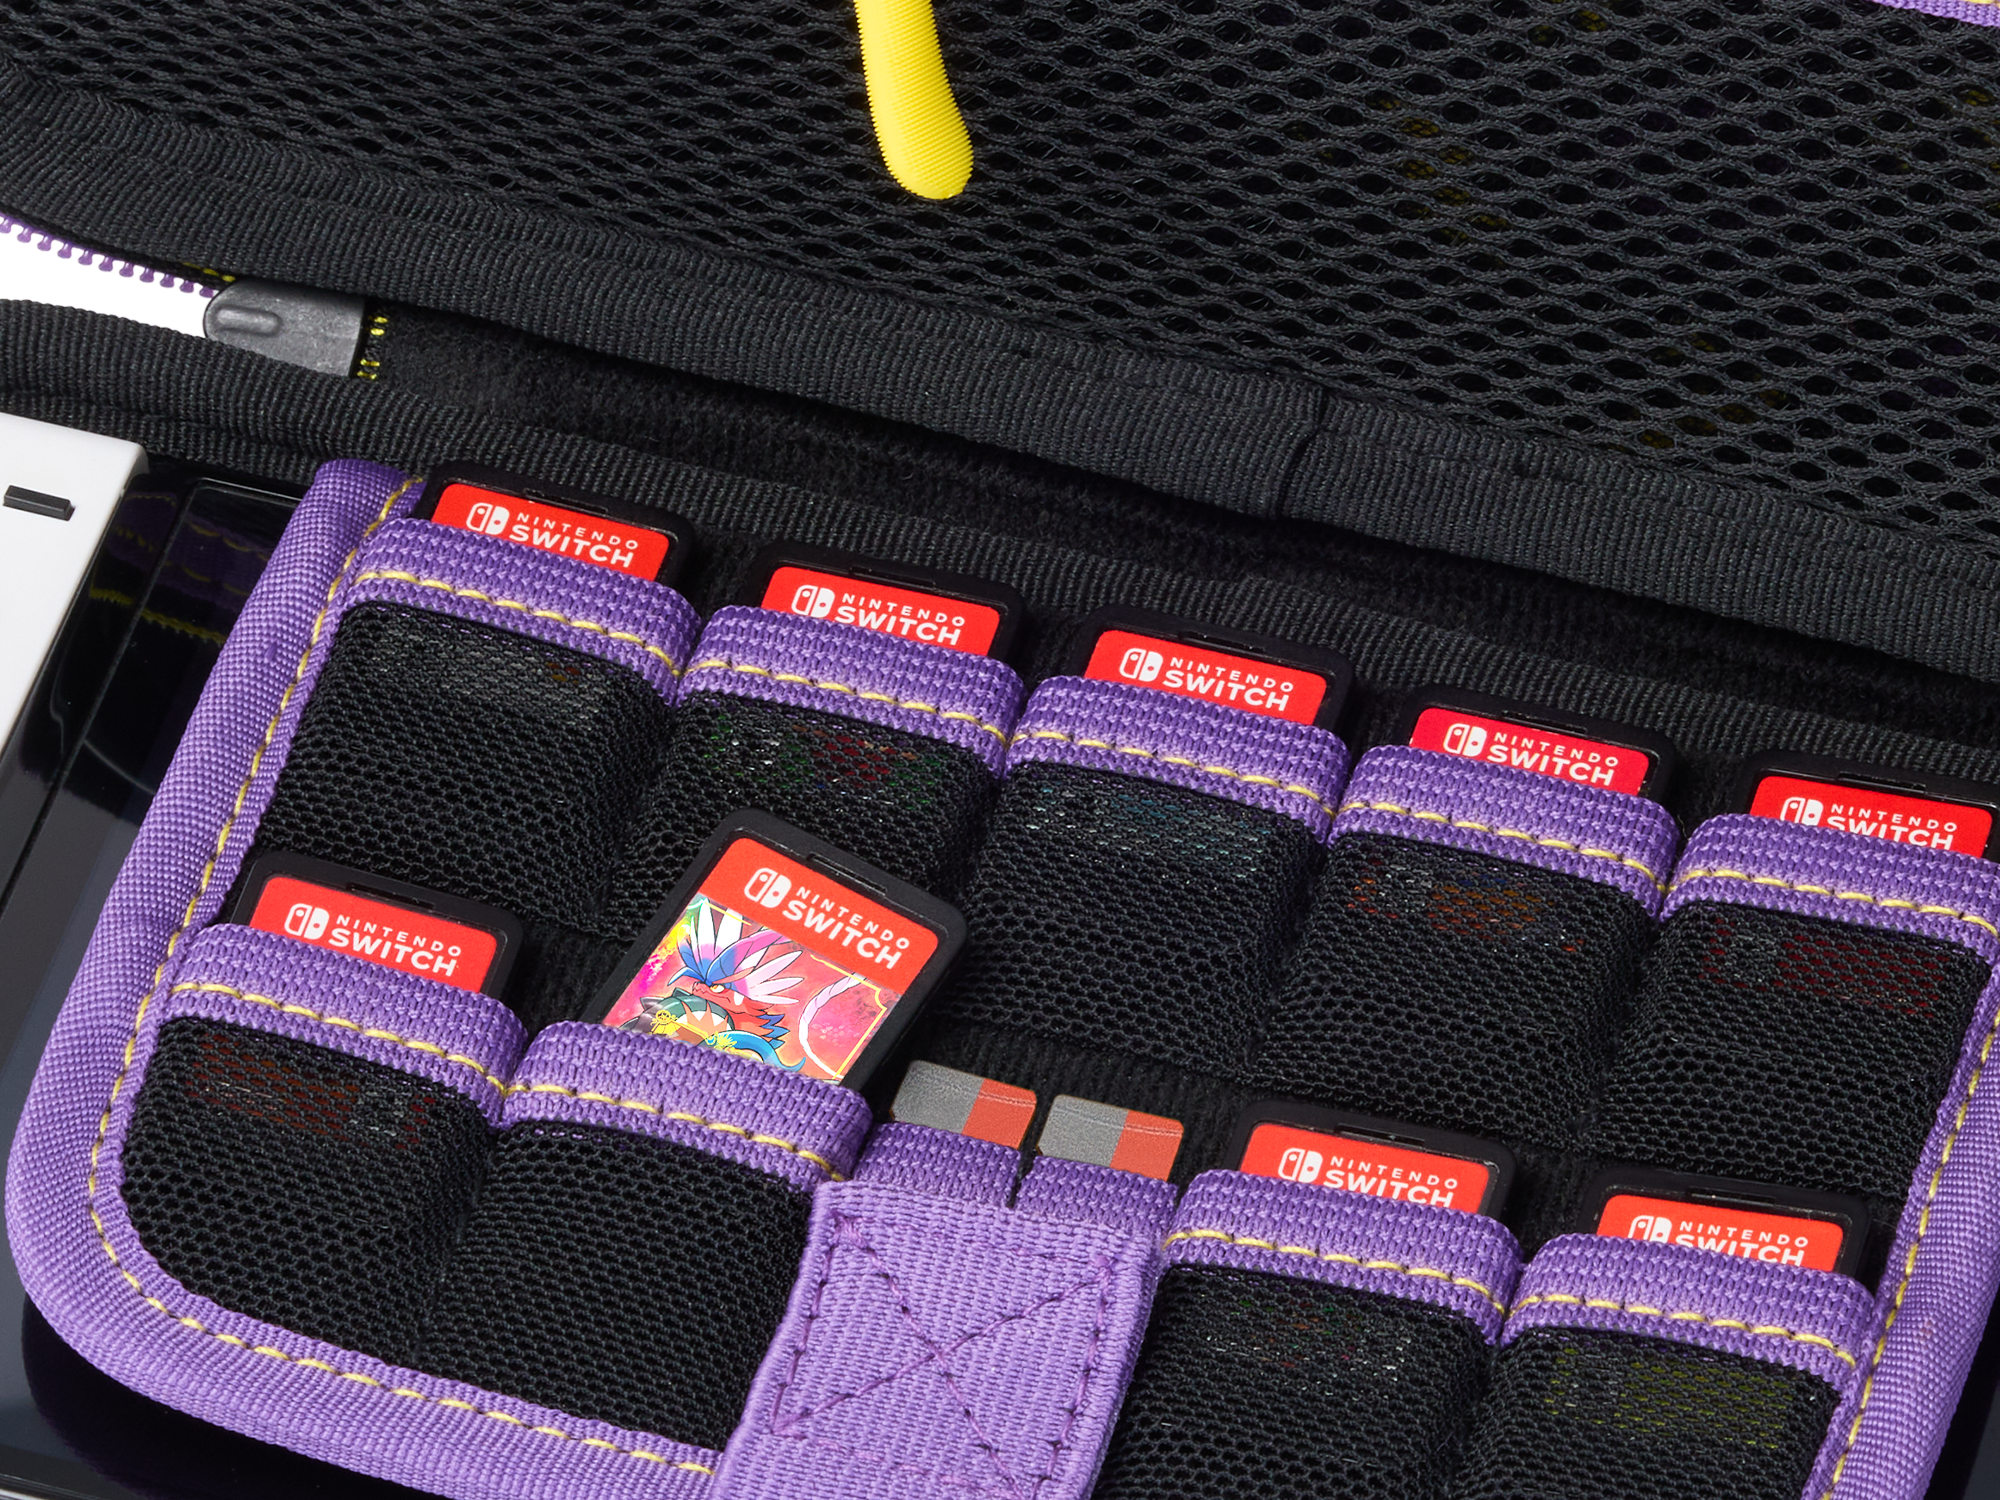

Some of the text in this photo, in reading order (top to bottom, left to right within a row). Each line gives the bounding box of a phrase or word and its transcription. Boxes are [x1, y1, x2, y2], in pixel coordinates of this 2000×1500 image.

[508, 525, 634, 567] SWITCH
[517, 513, 637, 550] NINTENDO
[834, 606, 962, 645] SWITCH
[841, 593, 965, 627] NINTENDO
[1163, 670, 1289, 711] SWITCH
[1169, 657, 1293, 692] NINTENDO
[1486, 745, 1615, 786] SWITCH
[1494, 733, 1619, 767] NINTENDO
[1826, 816, 1954, 850] SWITCH
[1830, 804, 1957, 833] NINTENDO
[335, 915, 461, 956] NINTENDO
[781, 899, 903, 969] SWITCH
[795, 887, 910, 950] NINTENDO
[327, 928, 458, 976] SWITCH
[1322, 1170, 1454, 1208] SWITCH
[1330, 1156, 1457, 1189] NINTENDO
[1675, 1234, 1805, 1267] SWITCH
[1679, 1221, 1808, 1248] NINTENDO
